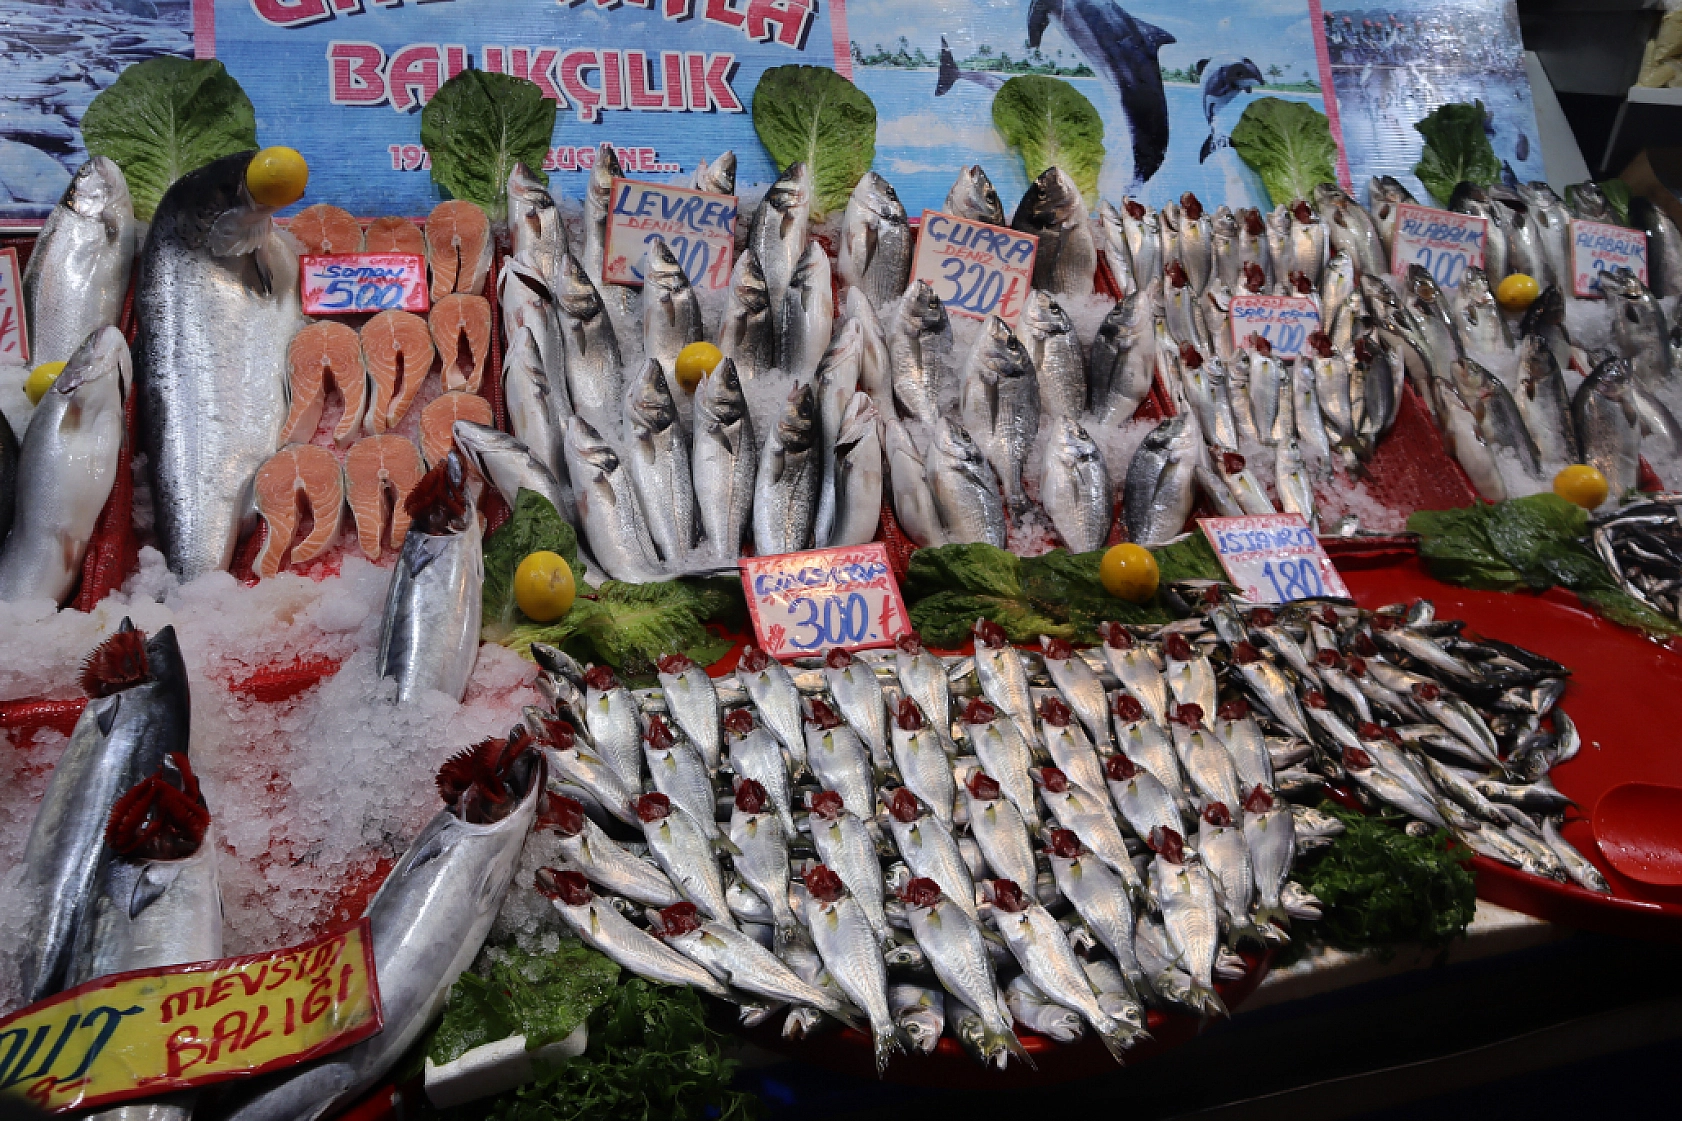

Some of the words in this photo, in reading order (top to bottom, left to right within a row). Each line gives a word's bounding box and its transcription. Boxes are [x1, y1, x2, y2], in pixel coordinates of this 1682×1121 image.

[541, 142, 682, 171] BUGNE...
[613, 185, 737, 236] LEVREK
[940, 258, 1004, 314] 320
[1262, 558, 1324, 604] 180
